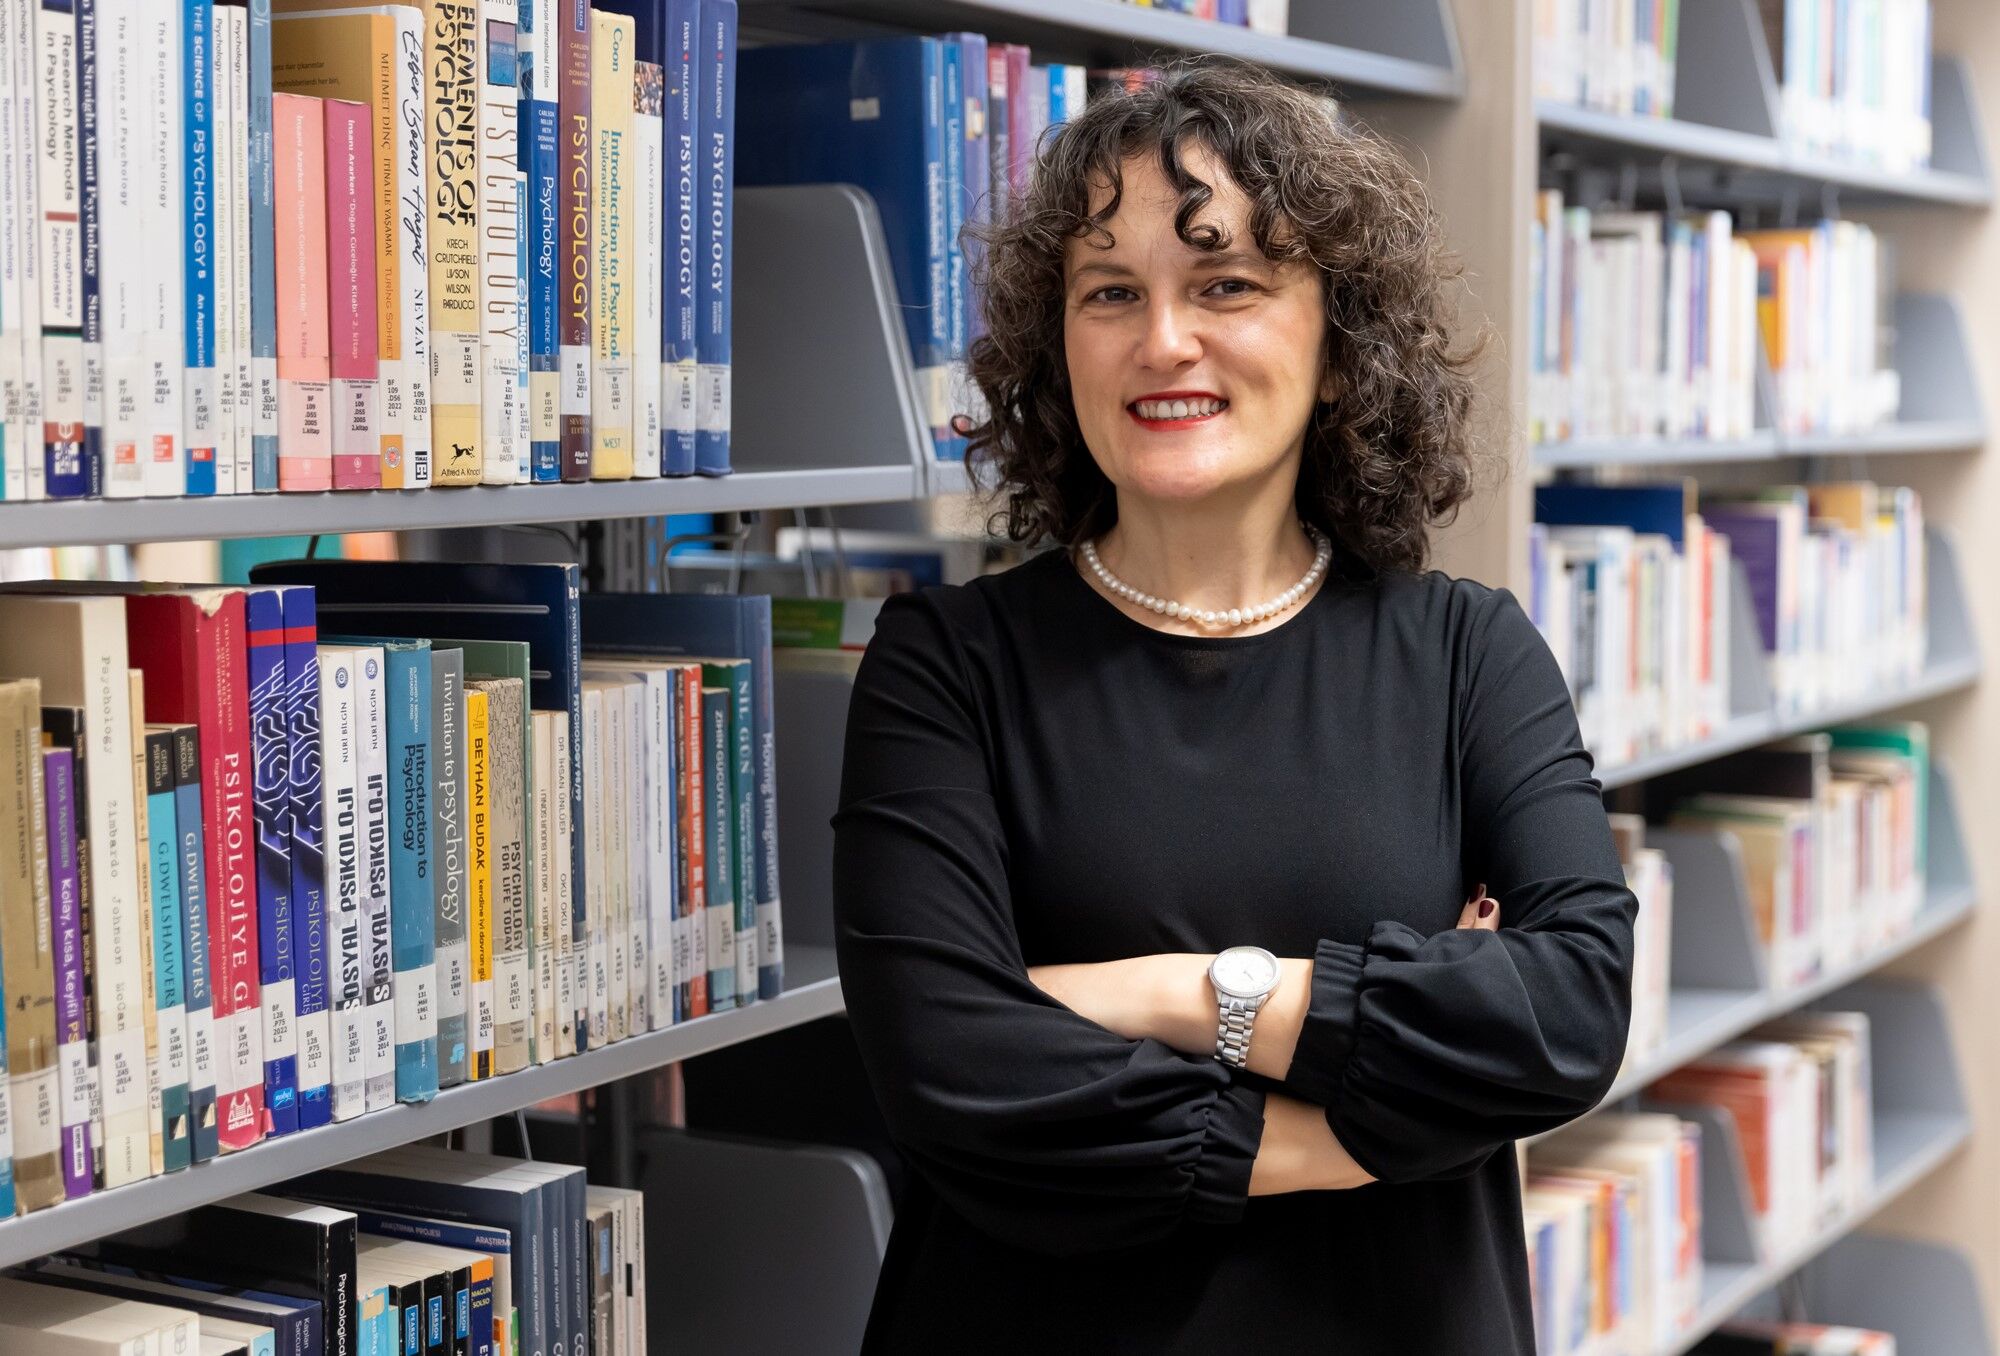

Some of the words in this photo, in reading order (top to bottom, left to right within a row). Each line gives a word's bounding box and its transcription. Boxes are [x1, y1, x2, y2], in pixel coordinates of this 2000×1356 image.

[47, 32, 57, 47] in
[81, 13, 95, 60] Think
[118, 17, 126, 39] The
[158, 21, 166, 44] The
[194, 5, 203, 32] THE
[214, 18, 223, 73] Psychology
[194, 36, 204, 98] SCIENCE
[233, 20, 243, 74] Psychology
[402, 30, 423, 100] Ezber
[611, 27, 623, 72] Coon
[62, 35, 72, 118] Research
[82, 64, 96, 128] Straight
[118, 47, 127, 103] Science
[158, 51, 167, 105] Science
[381, 52, 391, 112] MEHMET
[456, 5, 476, 170] ELEMENTS
[715, 63, 723, 119] PALLADINO
[23, 98, 31, 150] Research
[46, 54, 58, 160] Psychology
[119, 108, 128, 122] of
[159, 112, 167, 125] of
[194, 102, 204, 123] OF
[381, 116, 391, 150] DİNÇ
[435, 2, 456, 227] PSYCHOLOGY
[85, 133, 97, 181] About
[215, 120, 225, 176] Conceptual
[235, 121, 245, 176] Conceptual
[348, 120, 356, 151] İnsanı
[403, 99, 422, 176] Bozan
[25, 154, 34, 201] Methods
[64, 125, 74, 201] Methods
[118, 128, 129, 207] Psychology
[157, 131, 169, 209] Psychology
[348, 154, 356, 195] Ararken
[599, 129, 610, 208] Exploration
[193, 129, 206, 267] PSYCHOLOGY
[456, 179, 476, 227] OF
[610, 129, 622, 253] Introduction
[680, 134, 691, 299] PSYCHOLOGY
[711, 132, 724, 294] PSYCHOLOGY
[84, 186, 98, 277] Psychology
[218, 203, 226, 252] Historical
[238, 203, 246, 252] Historical
[383, 208, 393, 257] YAŞAMAK
[403, 185, 425, 272] Hayat
[446, 238, 469, 248] KRECH
[485, 103, 518, 339] PSYCHOLOGY
[539, 176, 555, 279] Psychology
[572, 115, 588, 325] PSYCHOLOGY
[599, 210, 608, 236] and
[4, 219, 14, 281] Psychology
[25, 218, 35, 279] Psychology
[52, 226, 61, 310] Zechmeister
[64, 227, 73, 318] Shaughnessy
[349, 237, 358, 283] Cüceloğlu
[434, 253, 478, 263] CRUTCHFIELD
[446, 269, 470, 279] LIVSON
[610, 257, 621, 278] to
[197, 293, 205, 307] An
[384, 267, 393, 309] TURİNG
[442, 299, 475, 310] PARDUCCI
[445, 285, 471, 294] WILSON
[599, 240, 609, 318] Application
[351, 333, 359, 359] kitap
[414, 289, 424, 357] NEVZAT
[603, 438, 620, 449] WEST
[441, 468, 460, 476] Alfred
[101, 656, 114, 754] Psychology
[340, 702, 348, 736] BİLGİN
[443, 671, 456, 758] Invitation
[573, 694, 581, 769] PSYCHOLOGY
[153, 744, 162, 787] PSİKOLOJİ
[160, 749, 168, 778] GENEL
[179, 735, 189, 778] PSİKOLOJİ
[186, 740, 194, 769] GENEL
[444, 760, 455, 777] to
[557, 736, 565, 752] DR.
[760, 732, 774, 797] Moving
[30, 727, 44, 830] Introduction
[56, 766, 66, 801] FULYA
[403, 744, 415, 851] Psychology
[415, 743, 427, 856] Introduction
[474, 738, 484, 807] BEYHAN
[558, 757, 566, 789] İHSAN
[574, 770, 582, 802] 98/99
[35, 836, 44, 853] to
[107, 800, 120, 879] Zimbardo
[223, 752, 247, 968] PSİKOLOJİYE
[337, 788, 357, 911] PSİKOLOJİ
[367, 774, 386, 898] PSİKOLOJİ
[439, 780, 465, 924] psychology
[475, 813, 485, 870] BUDAK
[501, 845, 510, 872] FOR
[761, 797, 778, 899] Imagination
[417, 859, 428, 878] to
[502, 877, 511, 904] LIFE
[33, 859, 49, 953] Psychology
[60, 878, 72, 925] Kolay,
[185, 832, 205, 998] G.DWELSHAUVERS
[510, 842, 523, 951] PSYCHOLOGY
[62, 929, 75, 967] Kısa,
[111, 896, 123, 966] Johnson
[157, 842, 176, 1008] G.DWELSHAUVERS
[306, 890, 323, 1011] PSİKOLOJİYE
[477, 917, 485, 931] iyi
[504, 910, 513, 952] TODAY
[219, 955, 228, 1005] Psychology
[371, 912, 391, 1002] SOSYAL
[64, 970, 79, 1017] Keyifli
[301, 983, 311, 1015] GİRİŞ
[273, 1027, 287, 1035] 2022
[308, 1052, 322, 1060] 2022
